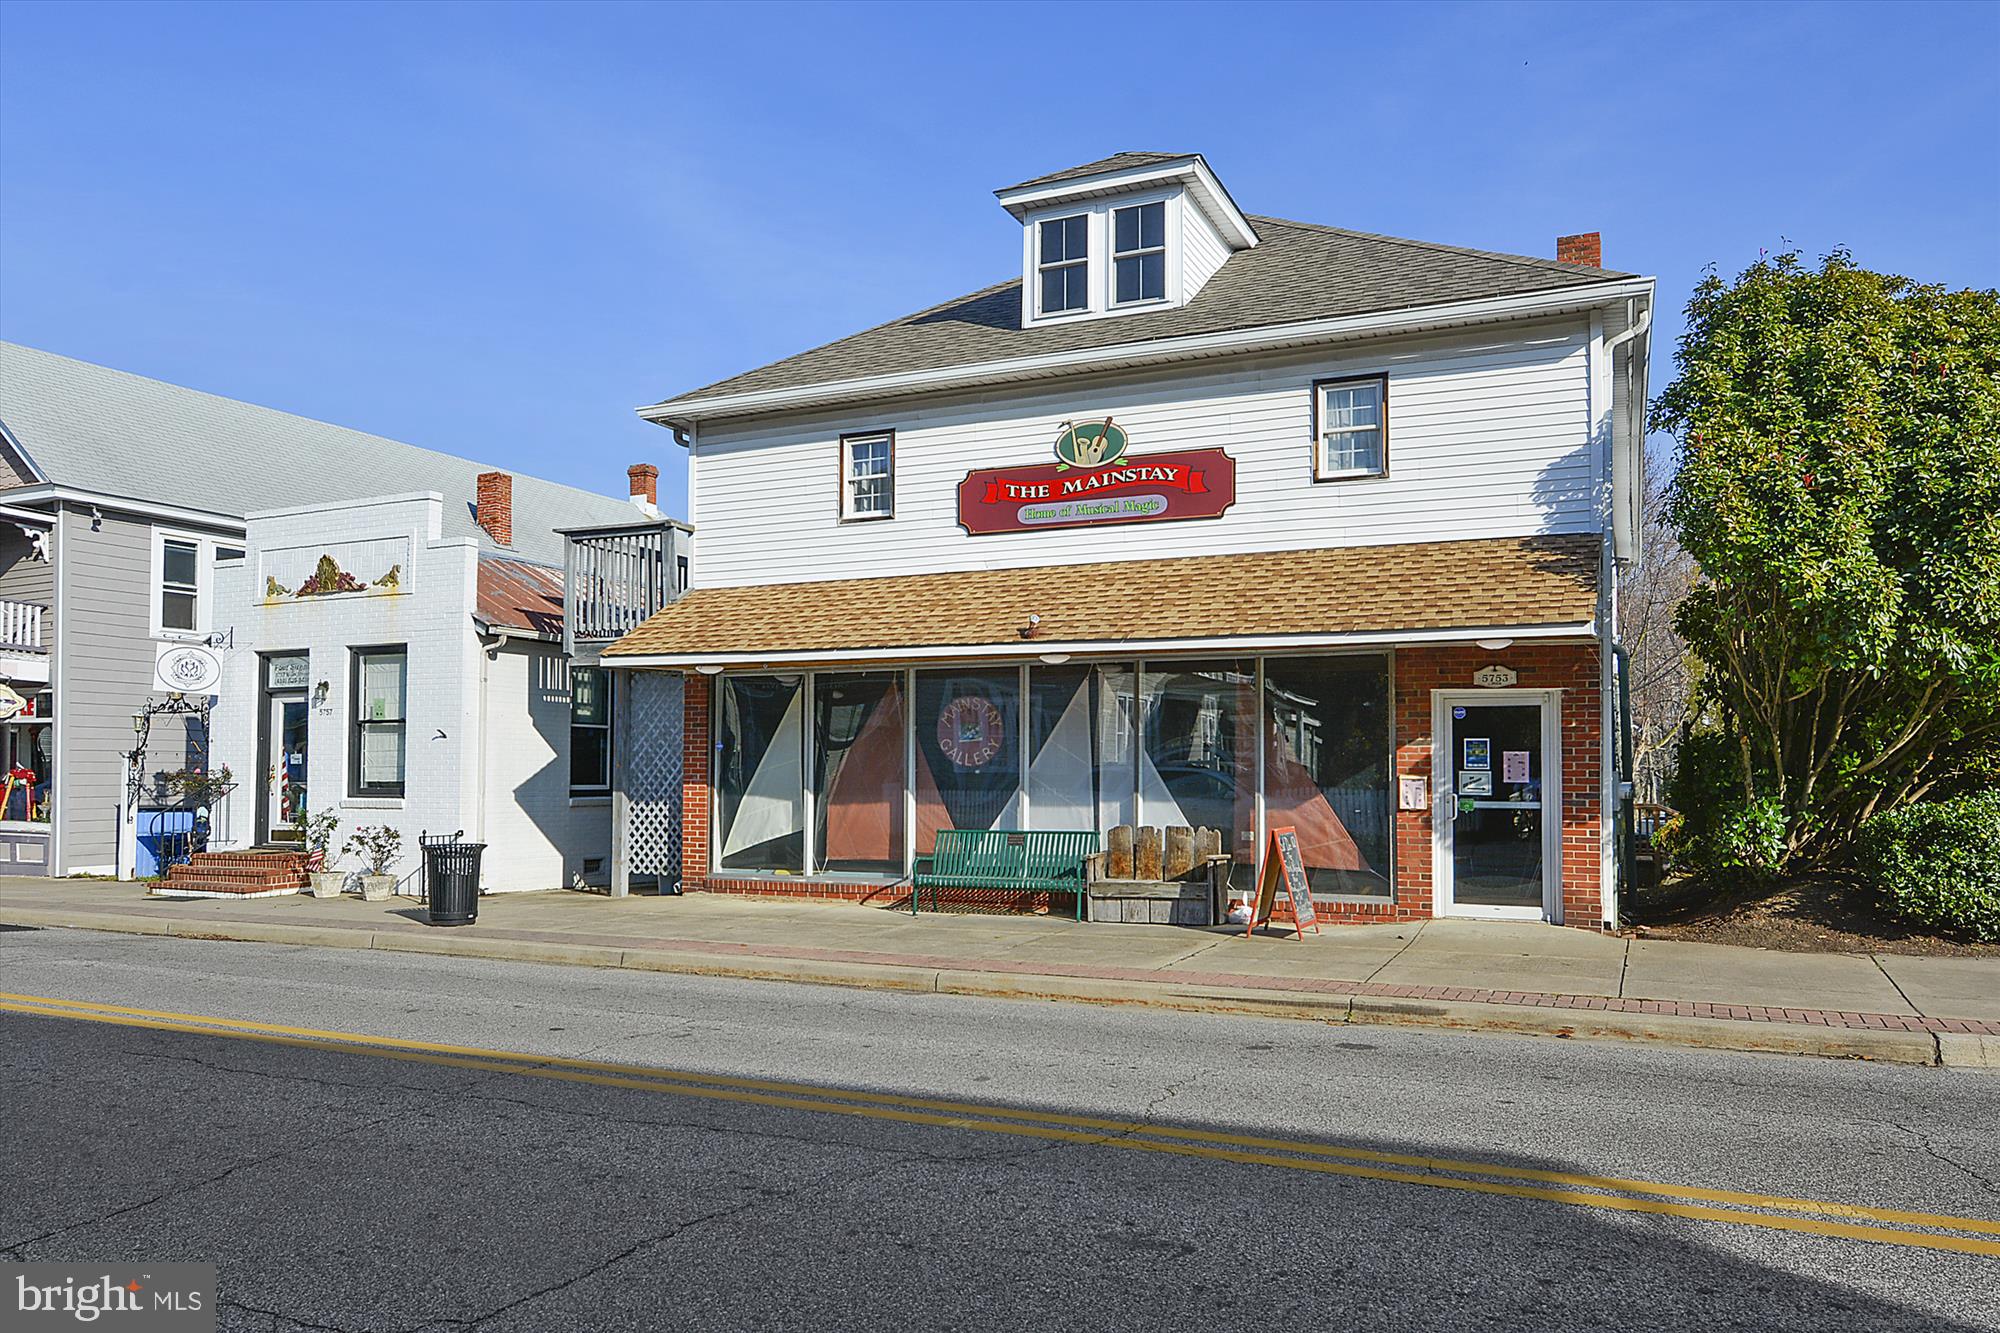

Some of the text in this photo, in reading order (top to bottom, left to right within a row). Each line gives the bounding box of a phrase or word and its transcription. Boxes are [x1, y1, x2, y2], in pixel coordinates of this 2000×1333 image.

[1006, 467, 1179, 498] THE MAINSTAY
[1024, 499, 1160, 520] Home of Musical Magic
[1481, 674, 1509, 683] 5753
[941, 697, 1002, 728] MAINSTAY
[940, 738, 1000, 767] GALLERY
